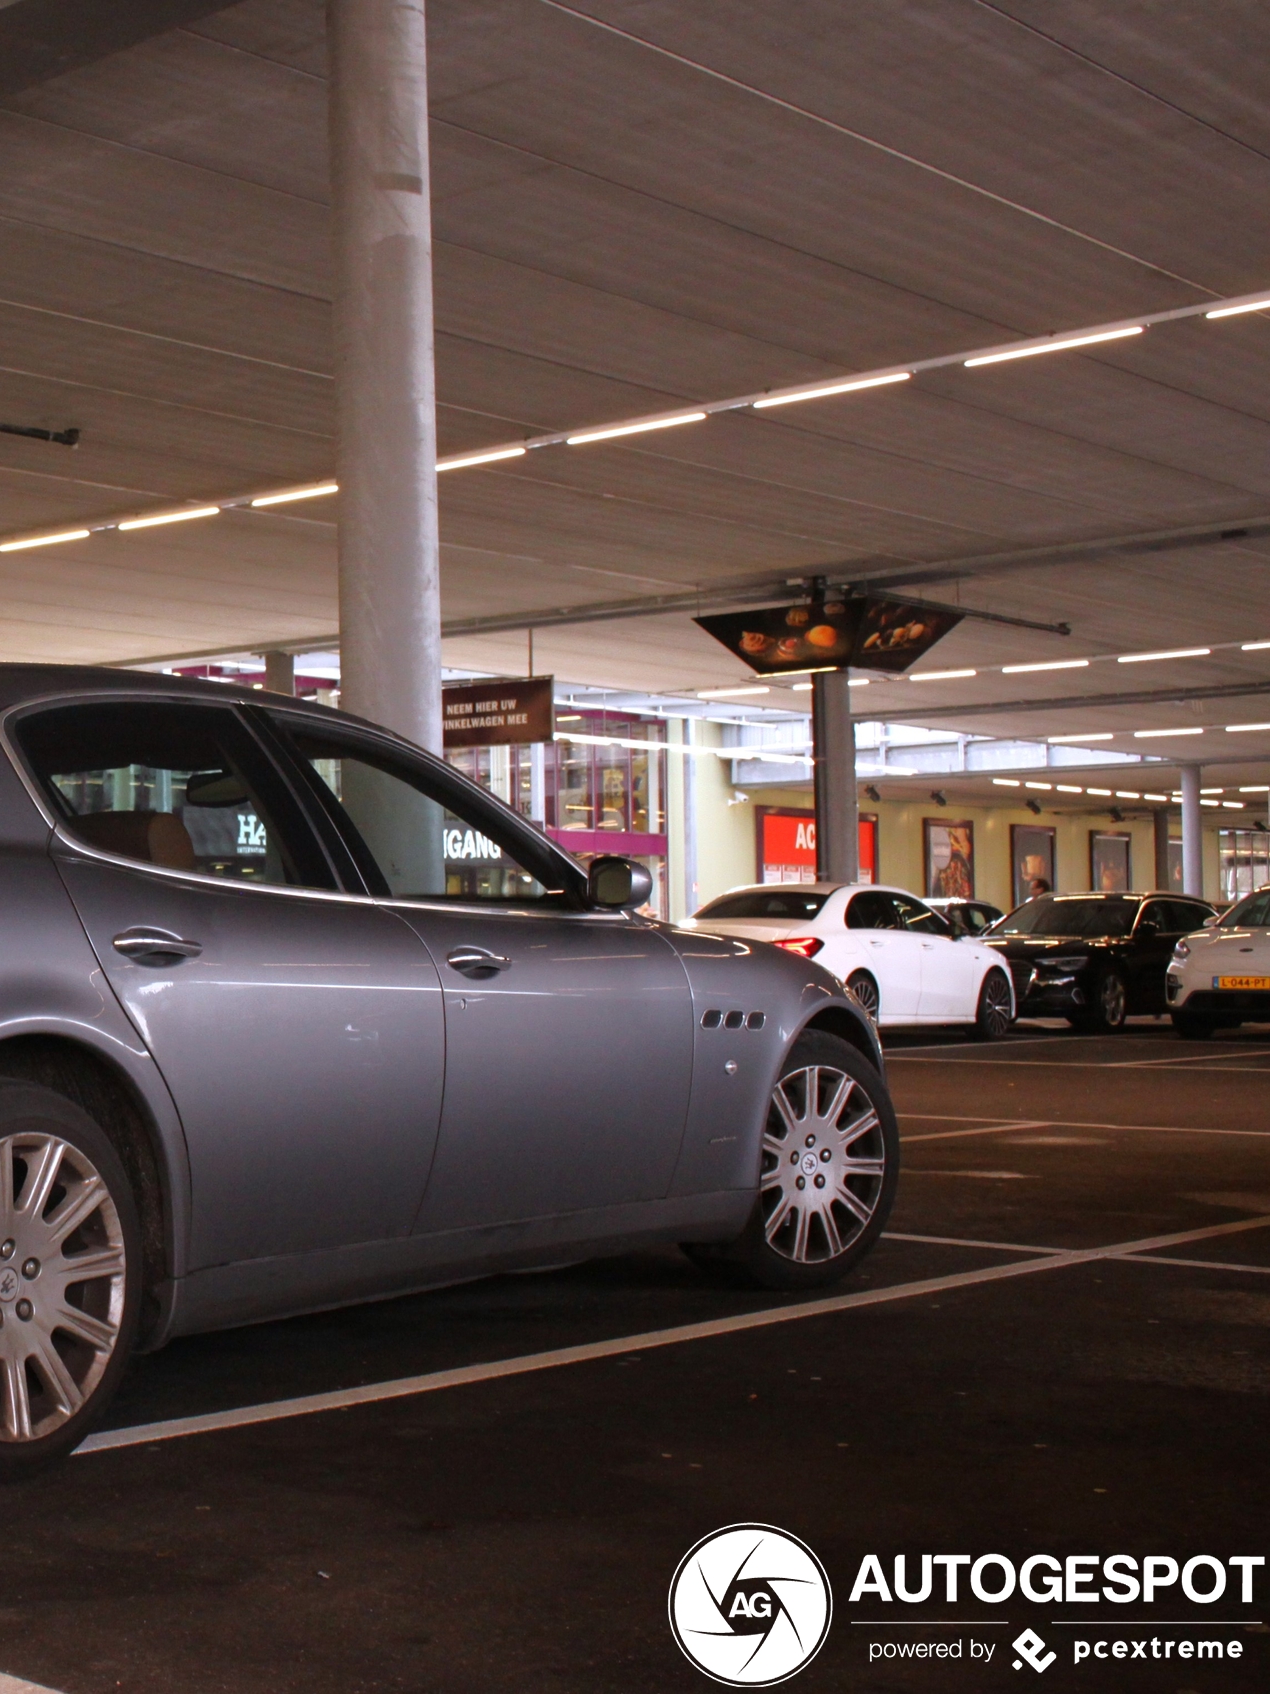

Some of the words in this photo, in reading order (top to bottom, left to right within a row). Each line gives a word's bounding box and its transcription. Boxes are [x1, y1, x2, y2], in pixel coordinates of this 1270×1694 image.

[446, 702, 473, 716] NEEM
[475, 700, 499, 713] HIER
[500, 698, 517, 711] UW
[443, 715, 505, 730] INKELWAGEN
[507, 713, 528, 725] MEE
